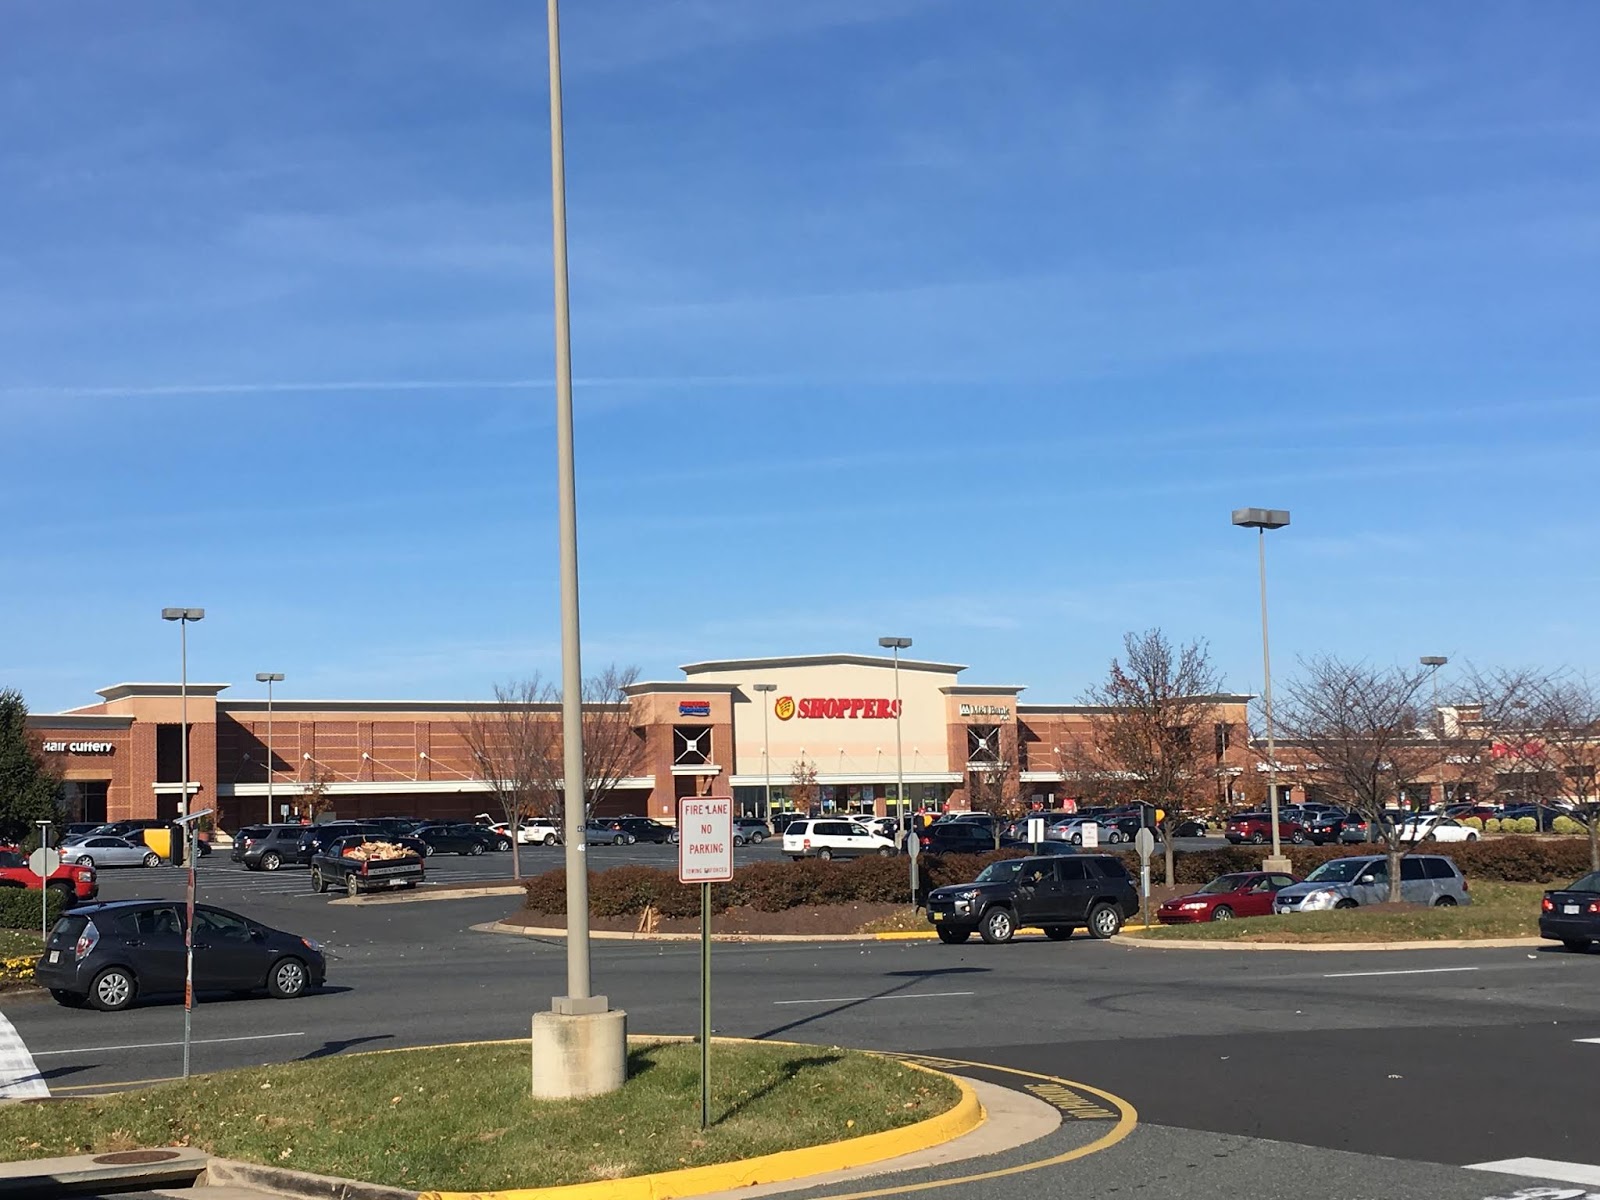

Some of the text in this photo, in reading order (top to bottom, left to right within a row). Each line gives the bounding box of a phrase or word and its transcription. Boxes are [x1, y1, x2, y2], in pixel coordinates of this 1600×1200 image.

[797, 698, 902, 719] SHOPPERS
[685, 804, 728, 815] FIRE LANE
[700, 824, 712, 834] NO
[689, 843, 724, 854] PARKING
